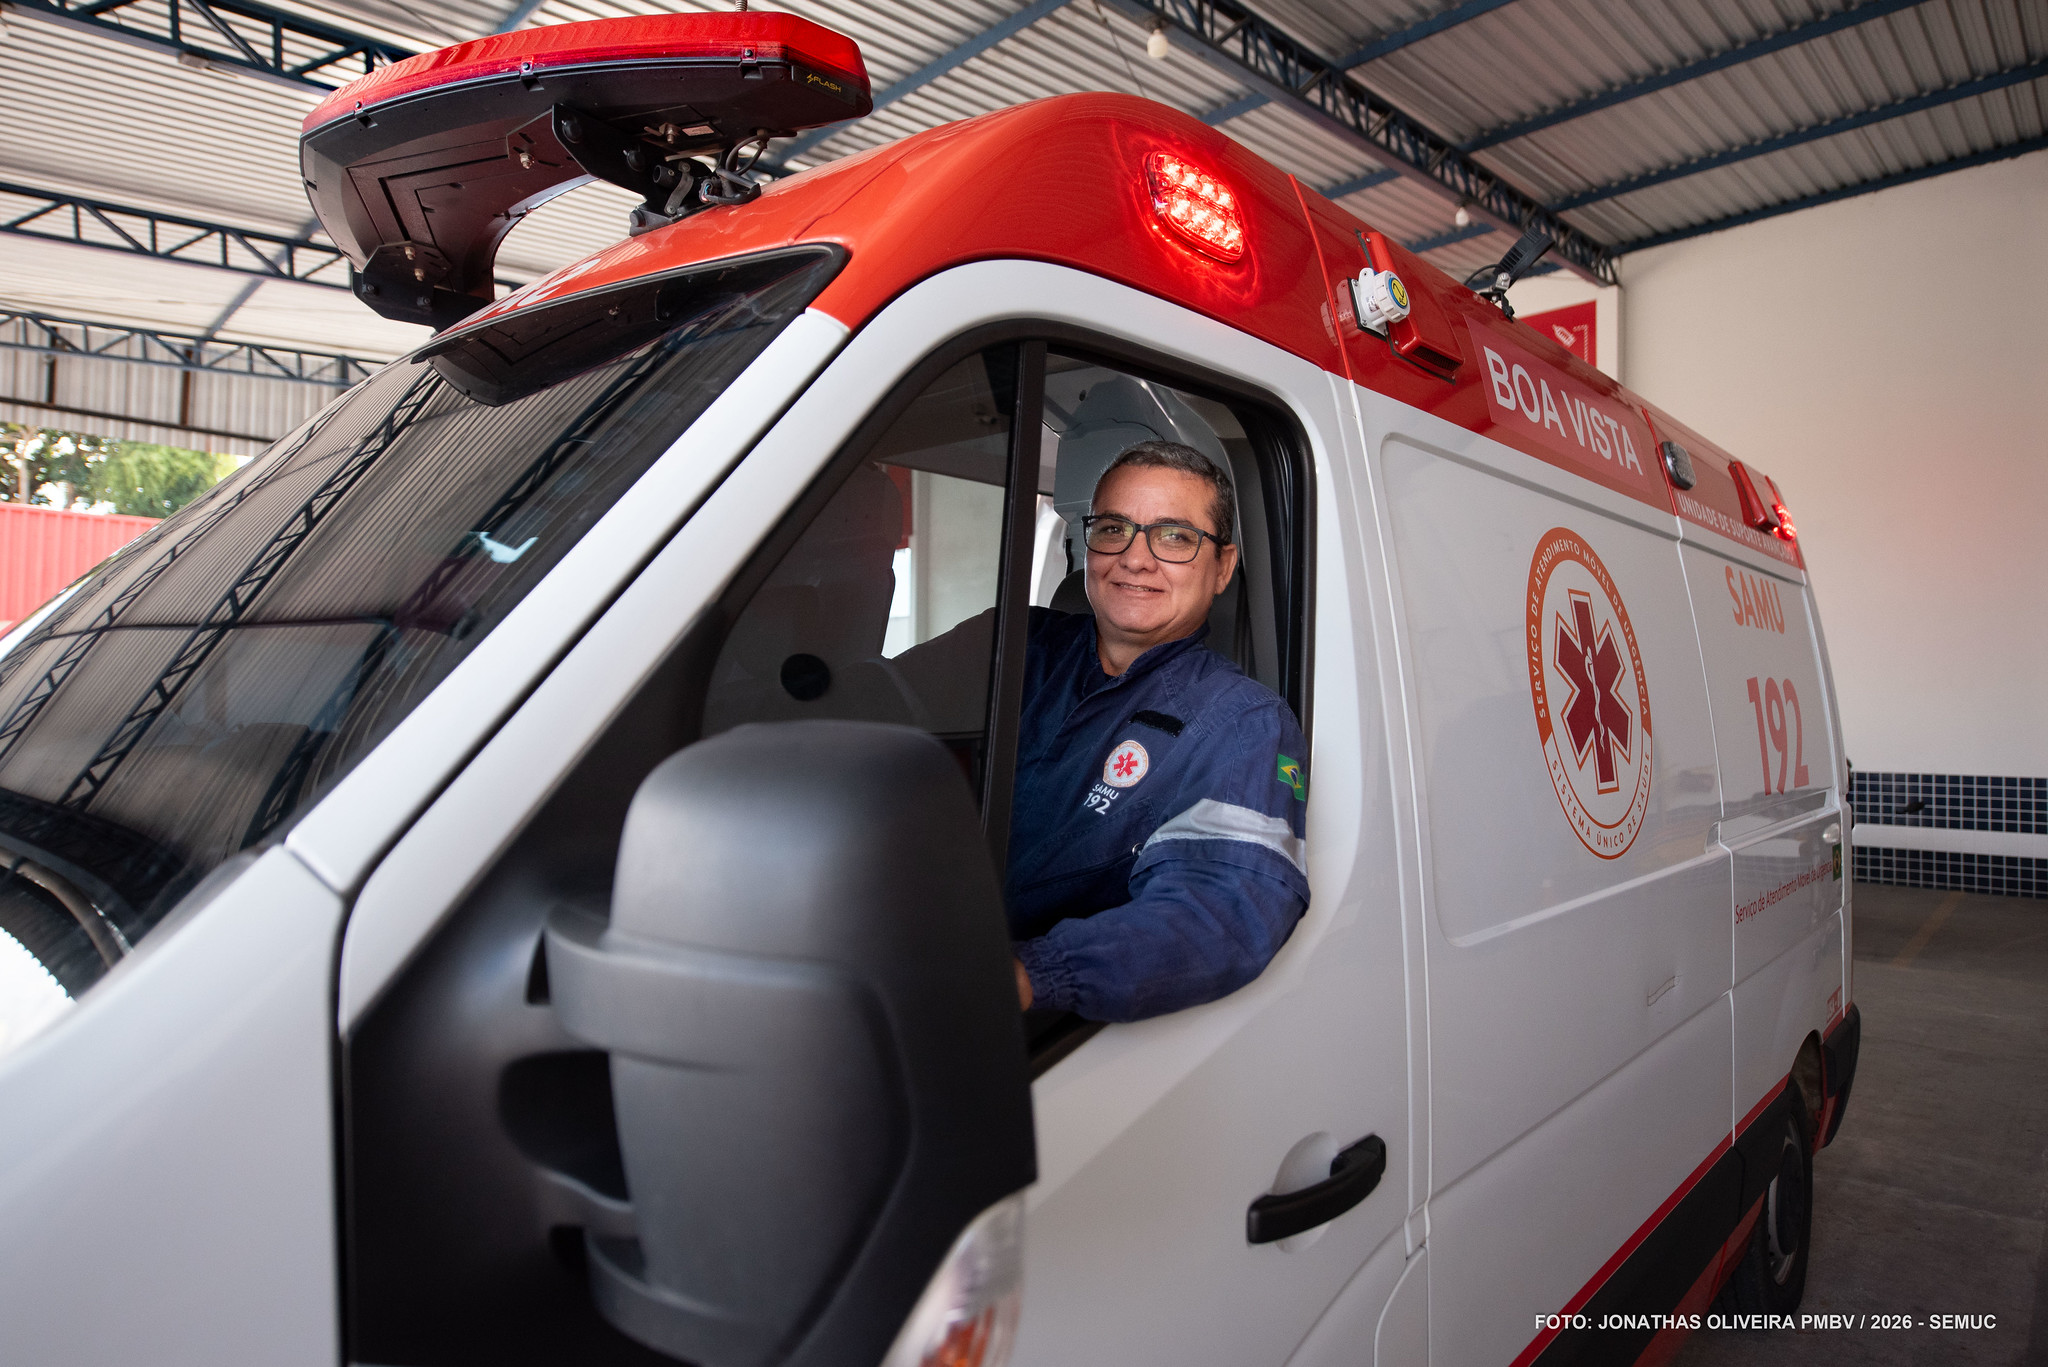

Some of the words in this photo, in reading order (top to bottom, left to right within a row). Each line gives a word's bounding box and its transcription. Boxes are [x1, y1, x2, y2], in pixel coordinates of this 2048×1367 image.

[1483, 345, 1567, 439] BOA
[1560, 389, 1644, 477] VISTA
[1677, 492, 1719, 529] UNIDADE
[1719, 512, 1731, 534] DE
[1535, 538, 1580, 590] ATENDIMENTO
[1583, 549, 1610, 593] MÓVEL
[1531, 591, 1539, 617] DE
[1612, 593, 1622, 617] DE
[1725, 565, 1785, 635] SAMU
[1531, 624, 1546, 719] SERVIÇO
[1746, 676, 1809, 797] 192
[1083, 792, 1111, 815] 192
[1092, 783, 1119, 800] SAMU
[1552, 760, 1591, 838] SISTEMA
[1596, 831, 1624, 848] ÚNICO
[1627, 815, 1637, 834] DE
[1735, 899, 1757, 924] Serviço
[1758, 891, 1765, 912] de
